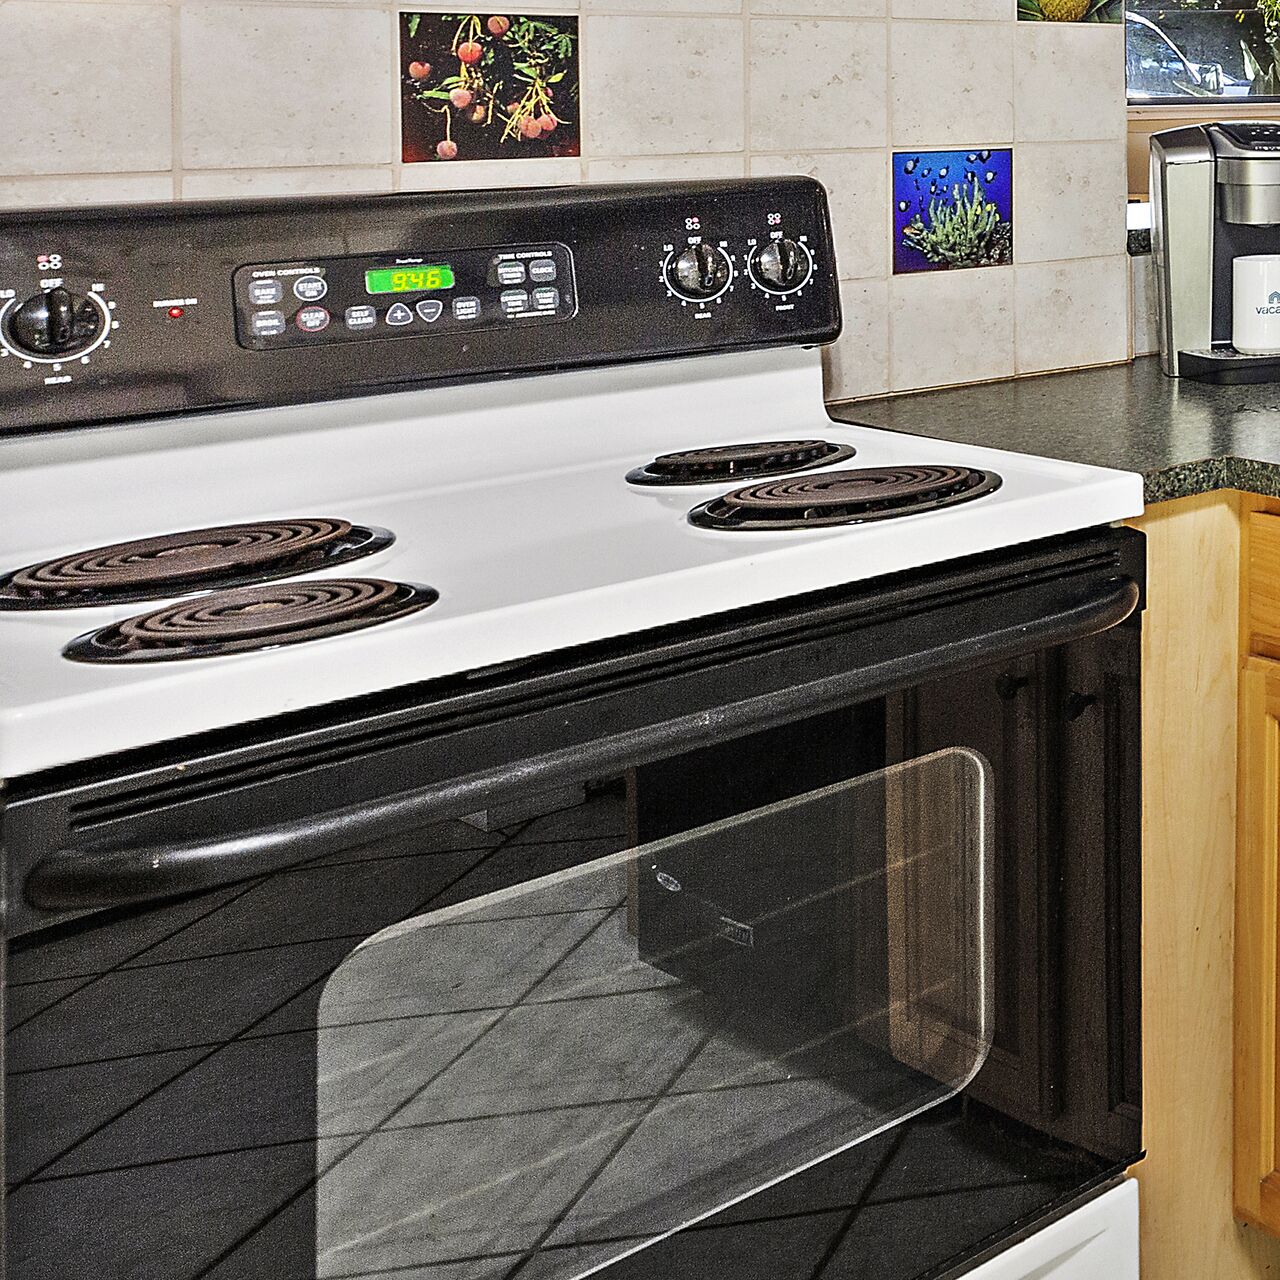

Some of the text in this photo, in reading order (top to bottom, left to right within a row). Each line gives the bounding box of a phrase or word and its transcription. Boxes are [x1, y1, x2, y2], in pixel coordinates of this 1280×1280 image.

[252, 267, 320, 278] OVEN CONTROLS
[532, 266, 553, 274] CLOCK
[40, 278, 64, 288] OFF
[392, 268, 441, 291] 9:46
[298, 282, 322, 291] START
[301, 312, 324, 321] CLEAR
[349, 317, 373, 325] CLEAN
[256, 319, 280, 327] BROIL
